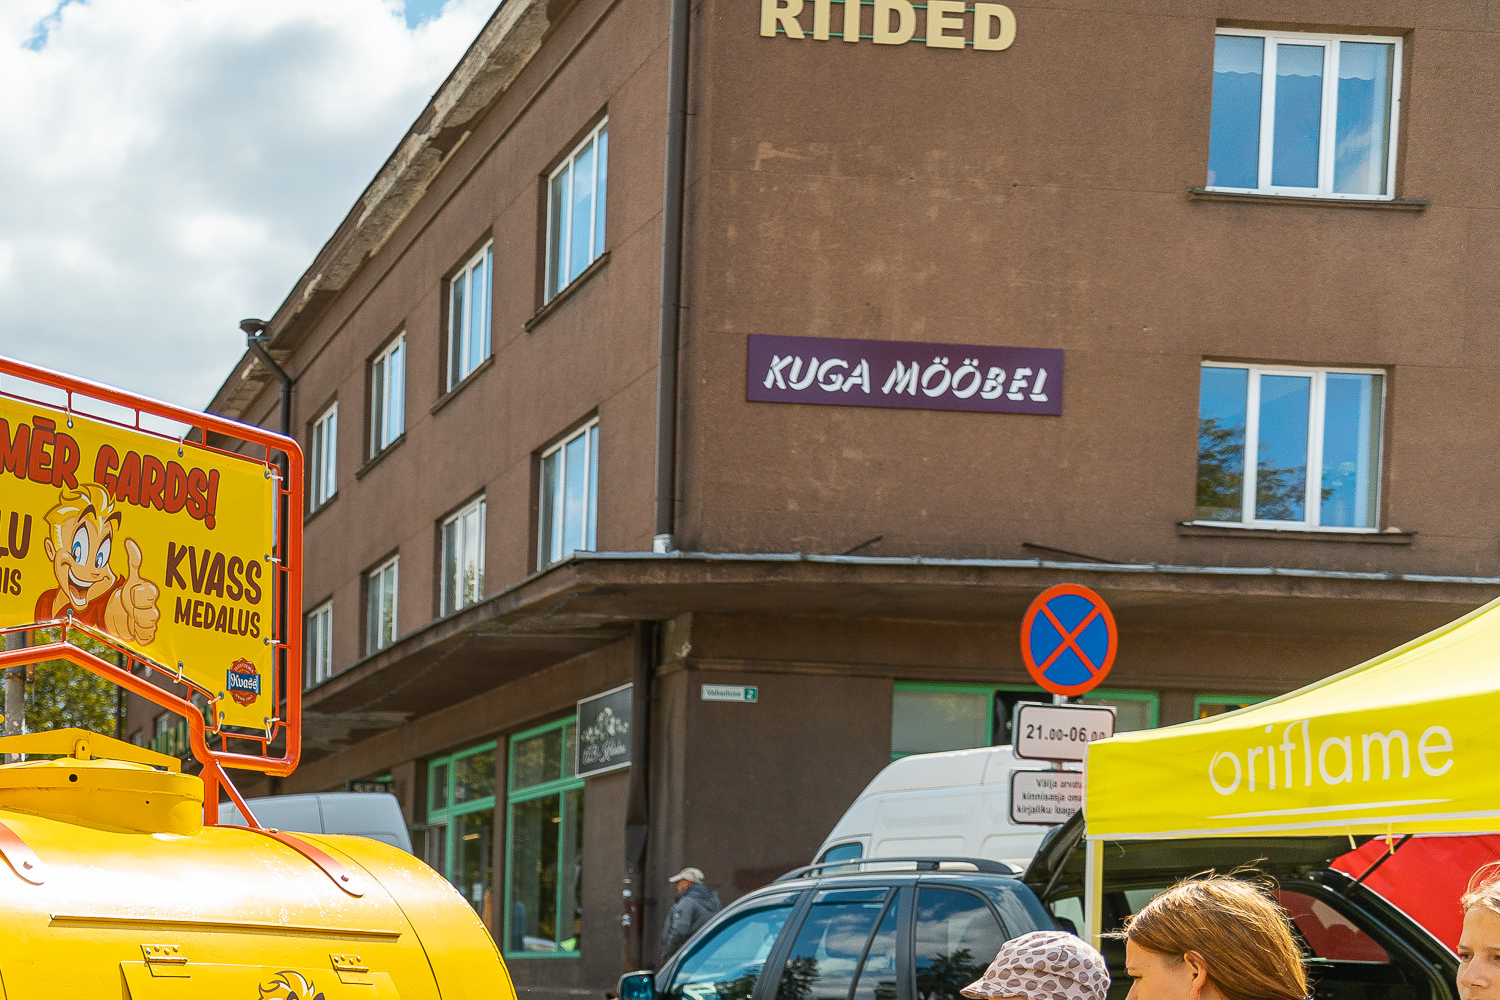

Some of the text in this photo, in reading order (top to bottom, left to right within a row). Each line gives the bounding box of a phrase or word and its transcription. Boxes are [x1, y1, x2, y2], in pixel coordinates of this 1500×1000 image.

[760, 0, 1017, 51] RIIDED
[762, 354, 1049, 402] KUGA MÖÖBEL
[93, 444, 220, 530] GARDS!
[165, 541, 262, 605] KVASS
[174, 596, 260, 638] MEDALUS
[230, 673, 257, 690] Kvass
[1208, 719, 1454, 796] oriflame
